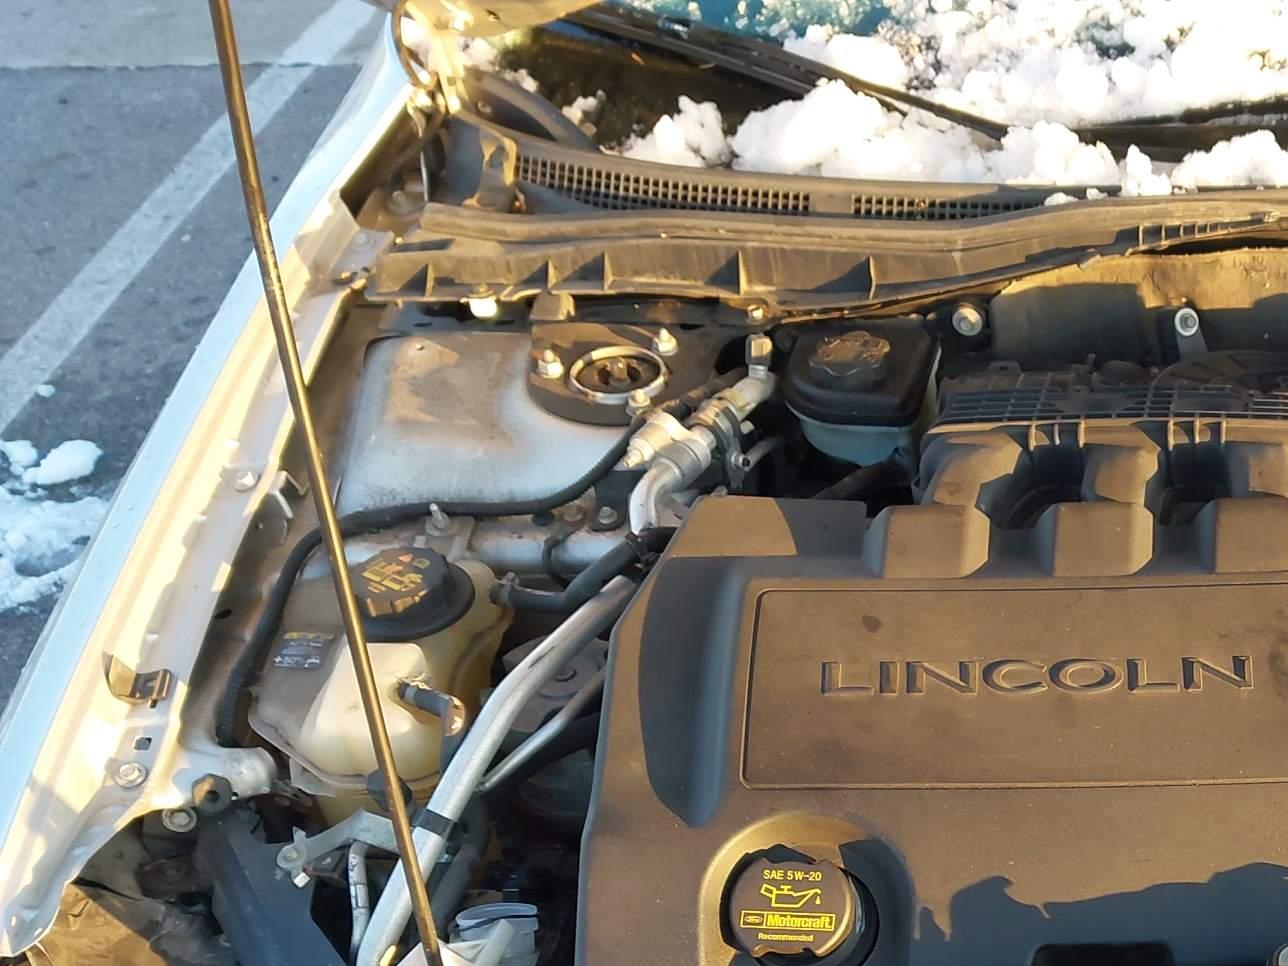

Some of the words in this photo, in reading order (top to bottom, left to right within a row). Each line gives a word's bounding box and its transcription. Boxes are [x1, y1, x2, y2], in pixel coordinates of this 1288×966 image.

[821, 656, 1254, 696] LINCOLN
[763, 869, 784, 880] SAE
[787, 871, 822, 882] 5W-20
[767, 914, 833, 929] Motorcraft
[758, 932, 814, 942] Recommended
